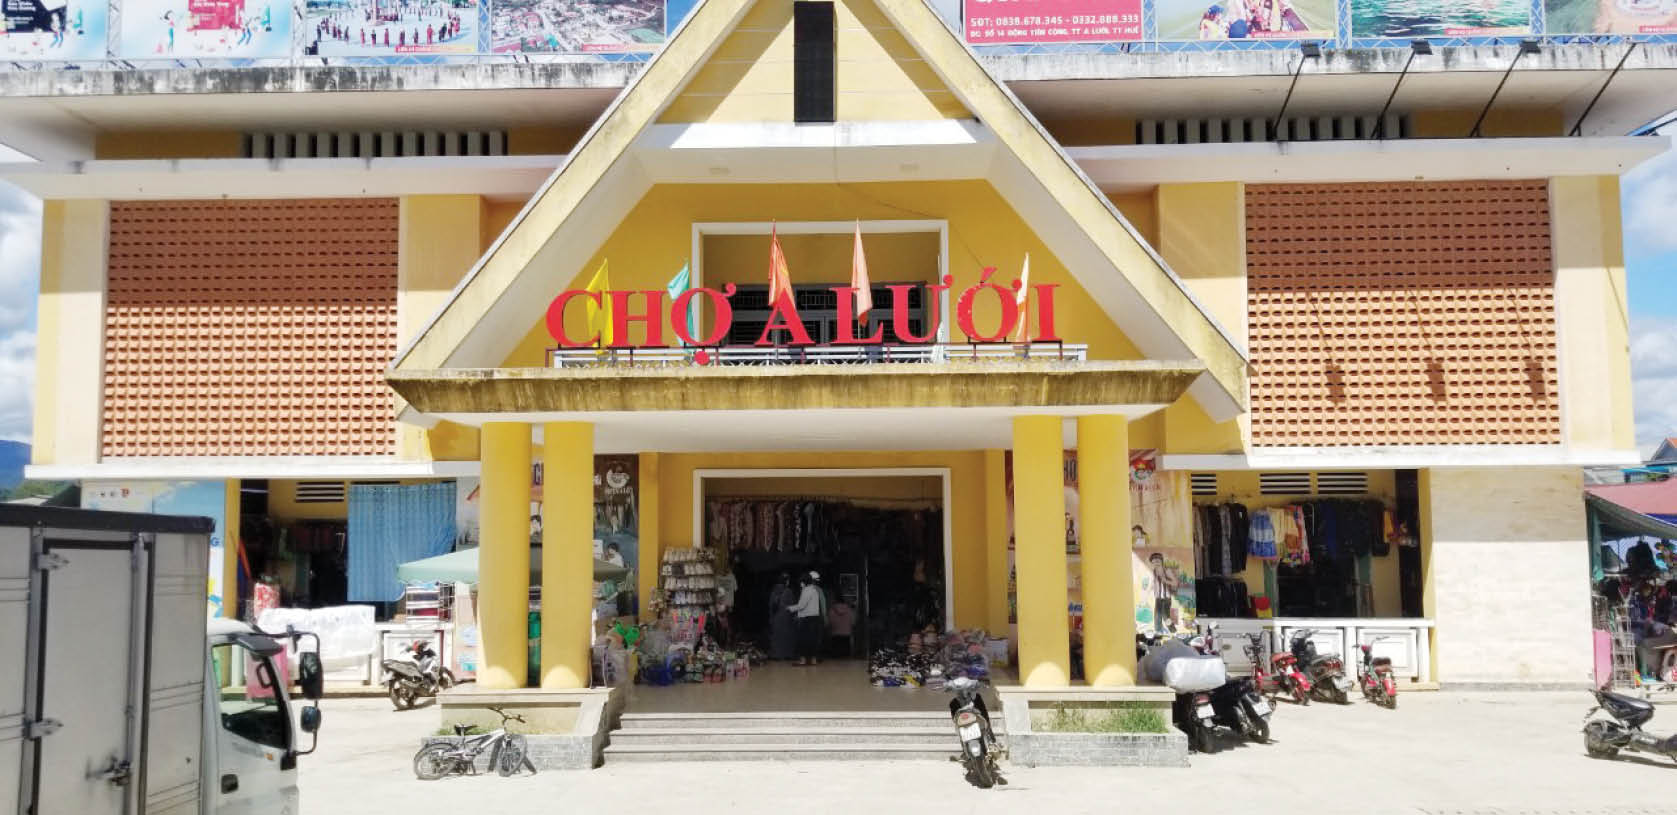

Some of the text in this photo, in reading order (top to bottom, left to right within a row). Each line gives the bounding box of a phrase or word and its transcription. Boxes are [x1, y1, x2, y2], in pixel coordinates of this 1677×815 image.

[546, 267, 1061, 365] CHỢ A LƯỚI
